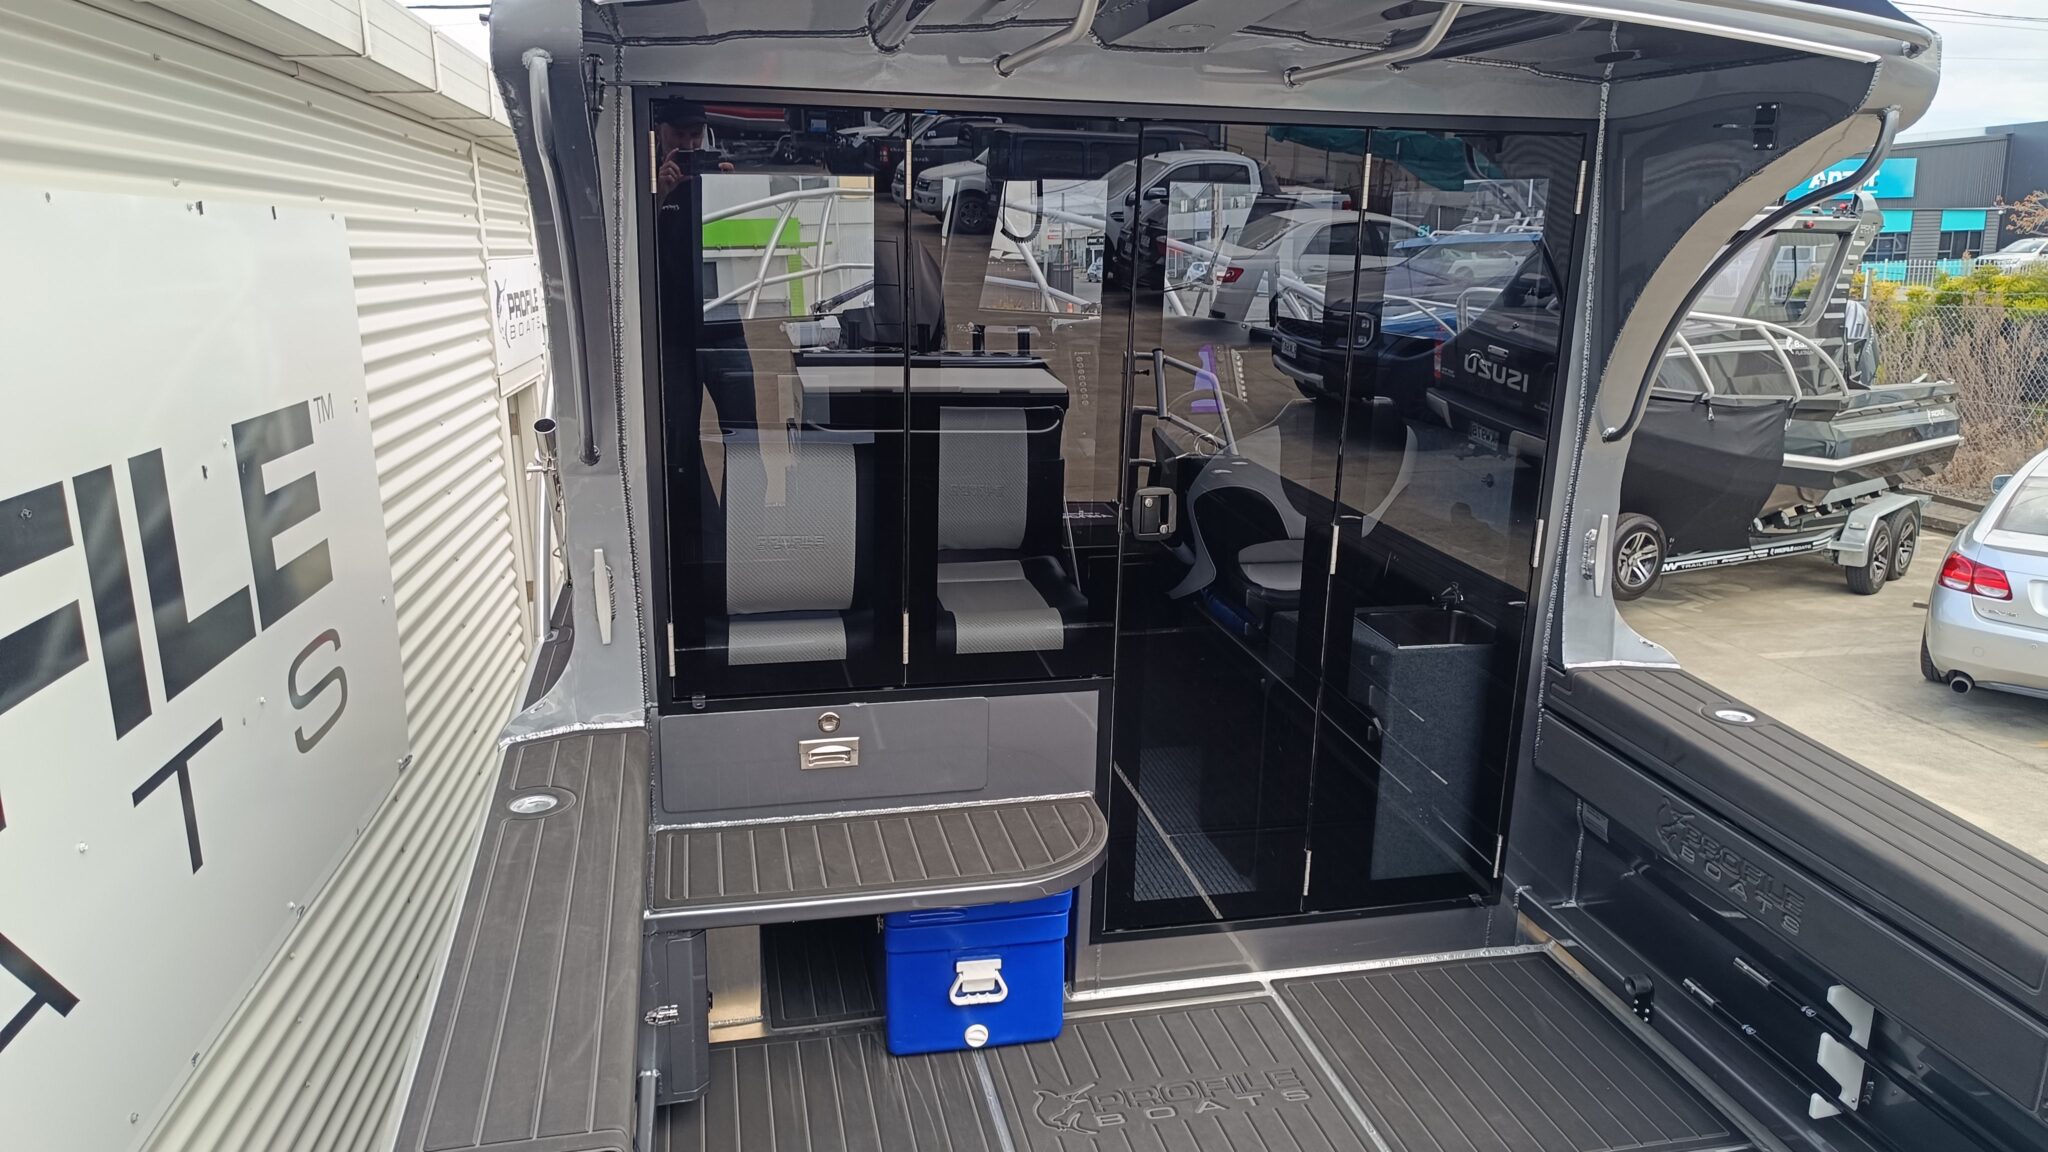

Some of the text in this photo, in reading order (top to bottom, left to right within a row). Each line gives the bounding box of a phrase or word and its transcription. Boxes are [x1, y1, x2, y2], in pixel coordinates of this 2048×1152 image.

[507, 288, 539, 320] PROFILE
[510, 316, 541, 340] BOATS
[1681, 560, 1718, 569] TRAILERS
[1679, 844, 1800, 935] BOATS
[1085, 1066, 1304, 1114] PROFILE
[1095, 1088, 1311, 1127] BOATS
